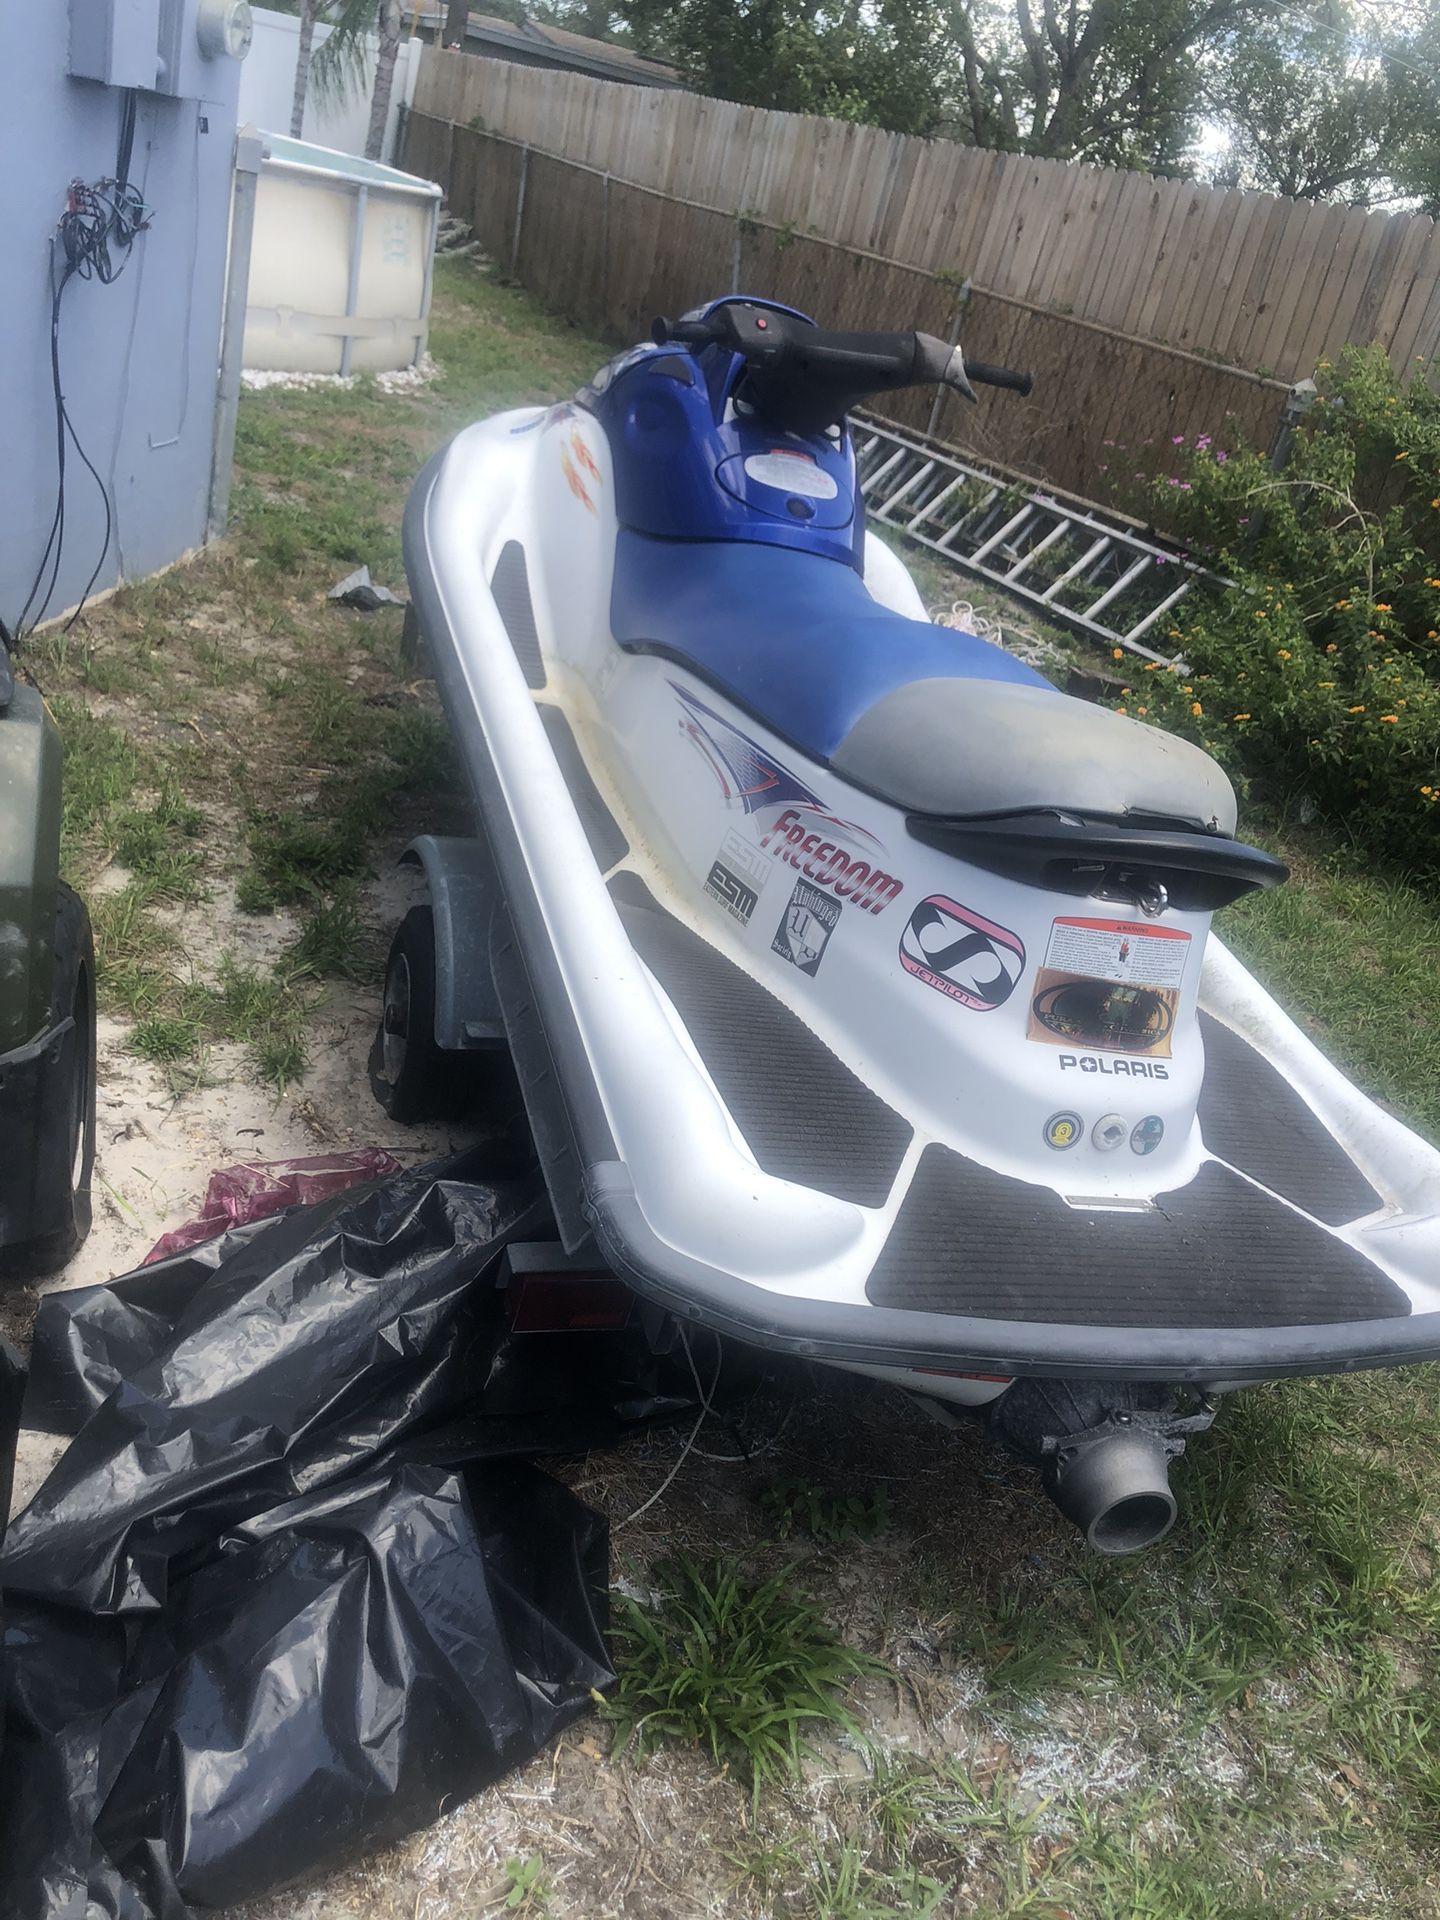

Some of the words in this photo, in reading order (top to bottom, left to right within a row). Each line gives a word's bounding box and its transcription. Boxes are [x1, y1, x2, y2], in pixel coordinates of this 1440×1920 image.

[760, 809, 903, 915] FREEDOM
[707, 860, 758, 919] ESM
[911, 961, 970, 1004] JETPILOT
[1058, 1054, 1169, 1080] POLARIS
